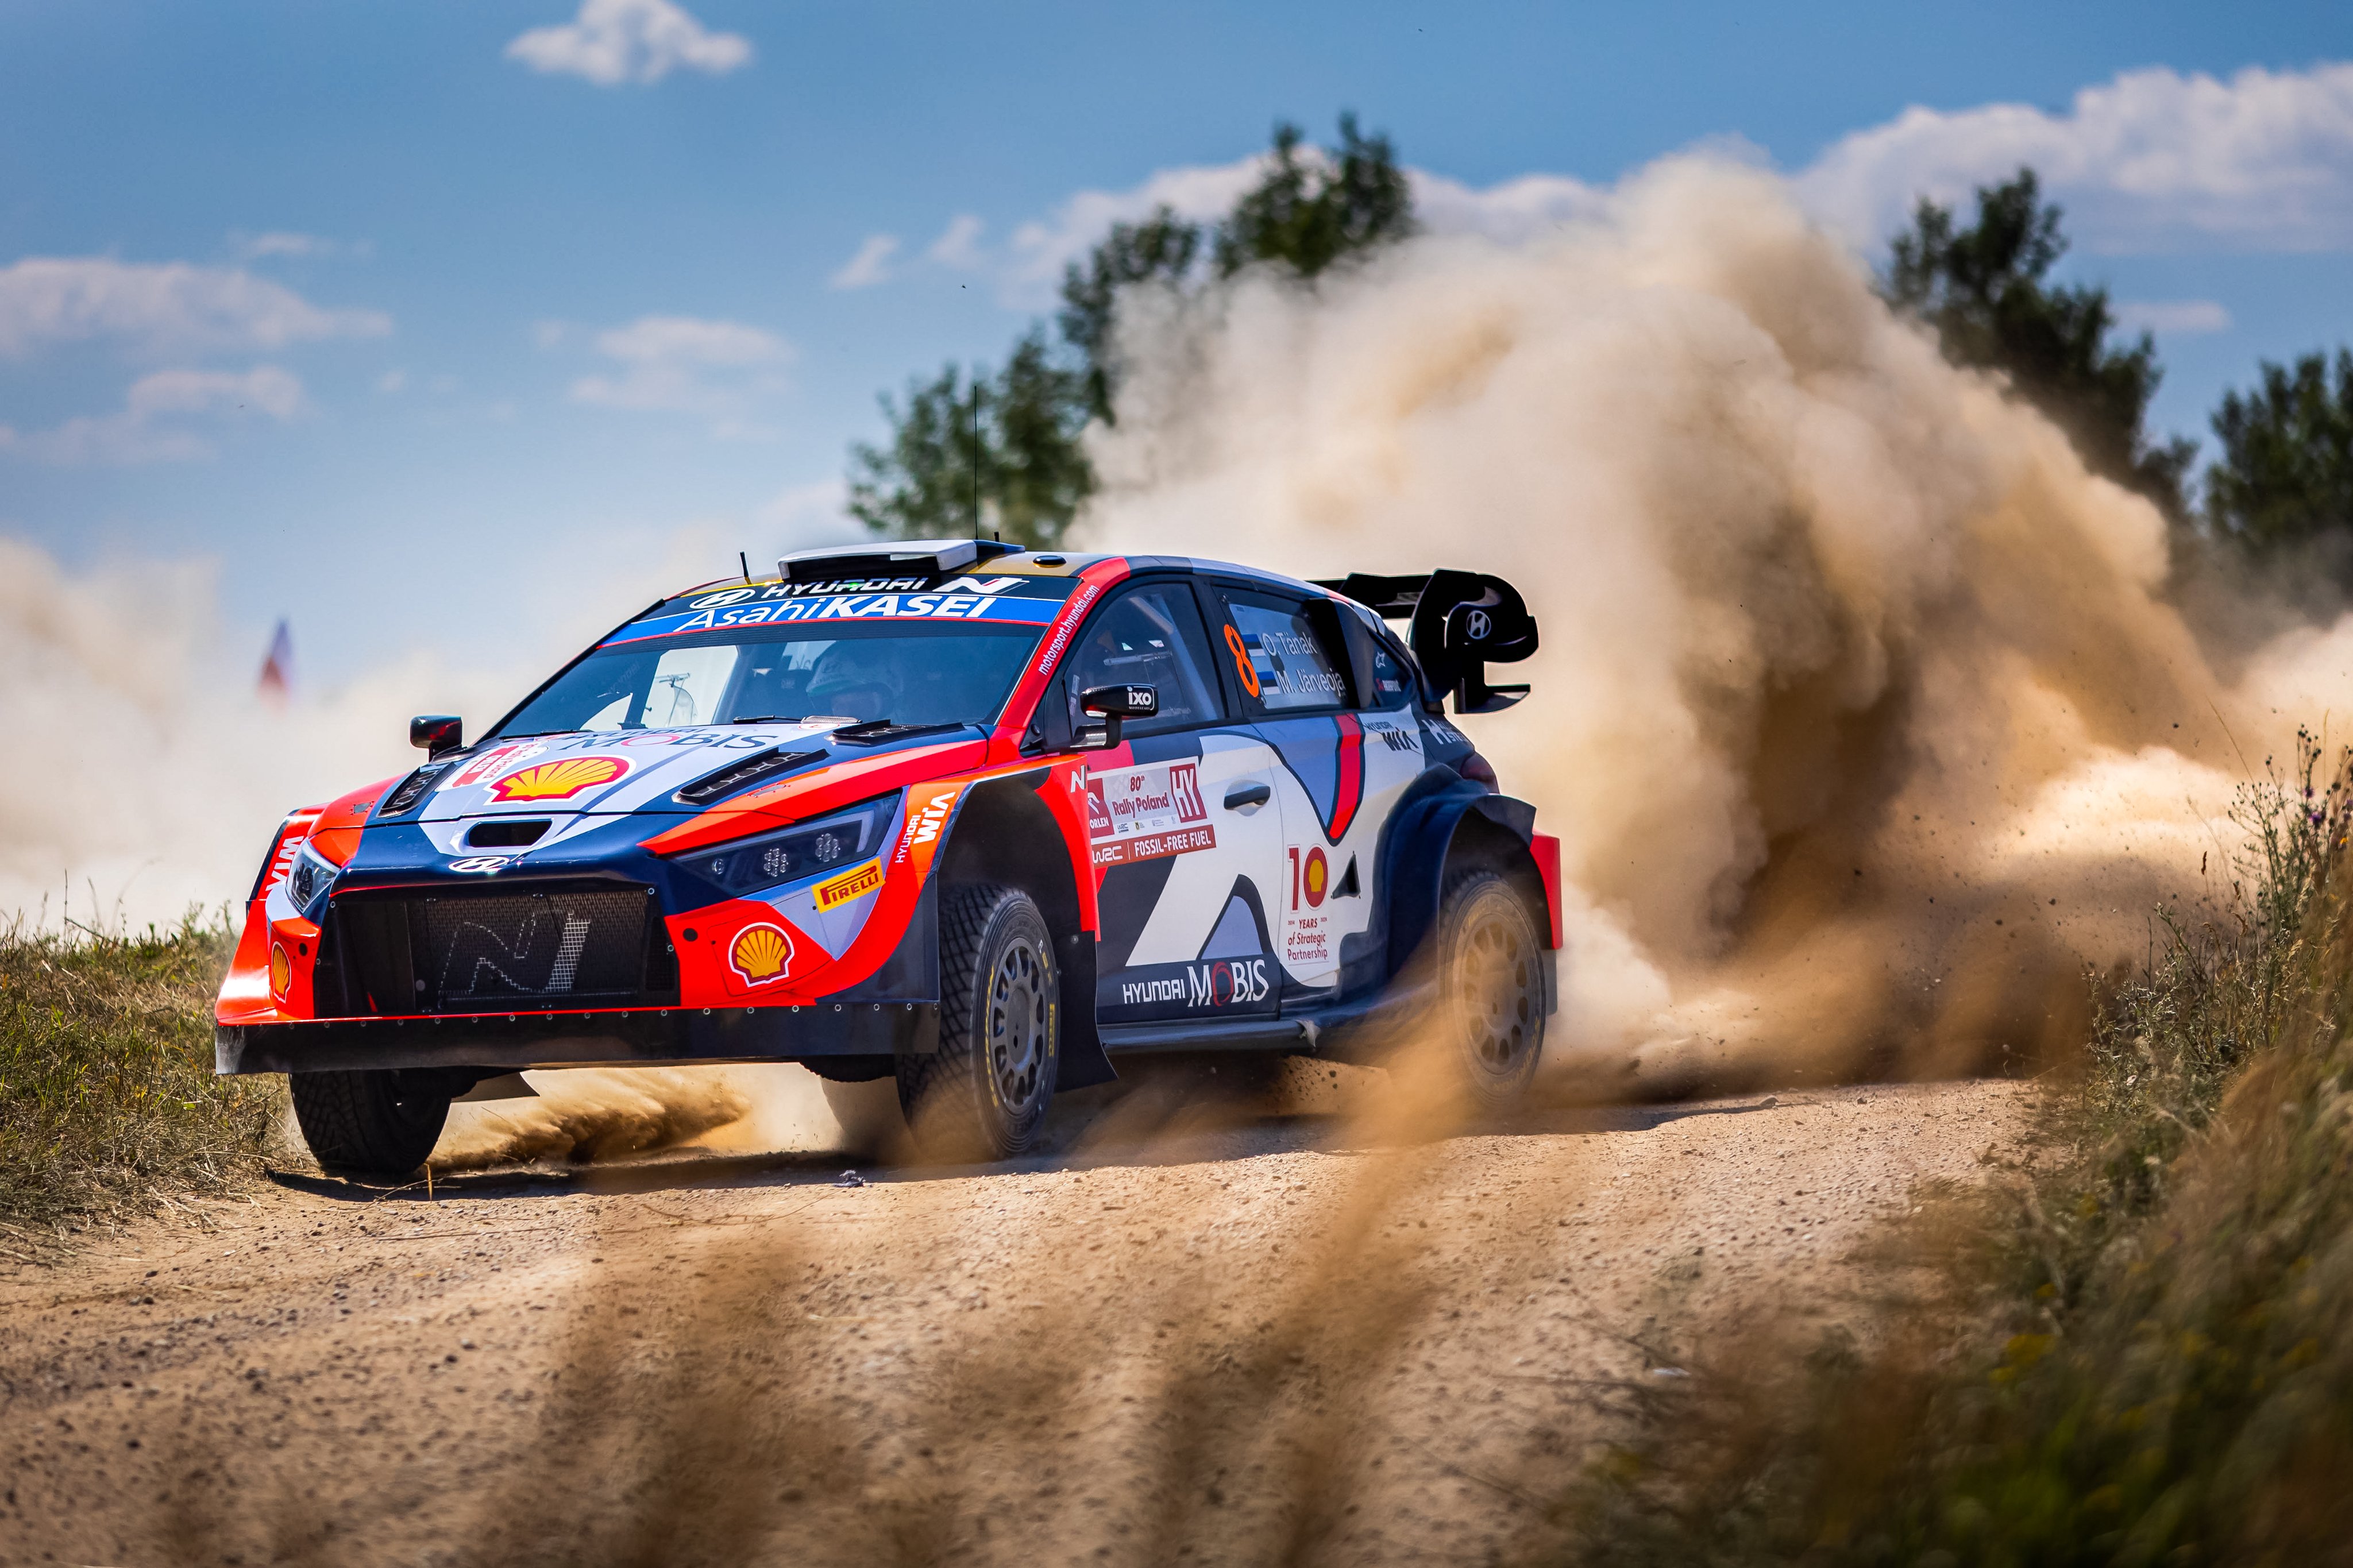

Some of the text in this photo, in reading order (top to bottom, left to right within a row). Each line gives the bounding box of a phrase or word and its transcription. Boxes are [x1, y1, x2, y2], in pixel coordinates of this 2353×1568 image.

[761, 577, 928, 598] HYUNDAI
[1038, 585, 1100, 676] motorsport.hyundai.com
[1262, 632, 1318, 656] O. Tänak
[1224, 624, 1259, 698] 8
[1276, 670, 1296, 694] M.
[1296, 667, 1346, 697] Järveoja
[558, 733, 778, 750] MOBIS
[561, 728, 708, 740] HYUNDAI
[1070, 764, 1086, 793] N
[1130, 775, 1145, 793] 80th
[1112, 792, 1170, 818] Rally Poland
[1171, 768, 1201, 818] HY
[1089, 816, 1110, 829] ORLEN
[895, 814, 921, 863] HYUNDAI
[1091, 830, 1212, 864] WRC FOSSIL-FREE FUEL
[819, 864, 879, 906] PIRELLI
[1299, 918, 1318, 929] YEARS
[1287, 930, 1326, 947] of Strategic
[1287, 945, 1328, 961] Partnership
[1123, 959, 1269, 1007] HYUNDAI MOBIS
